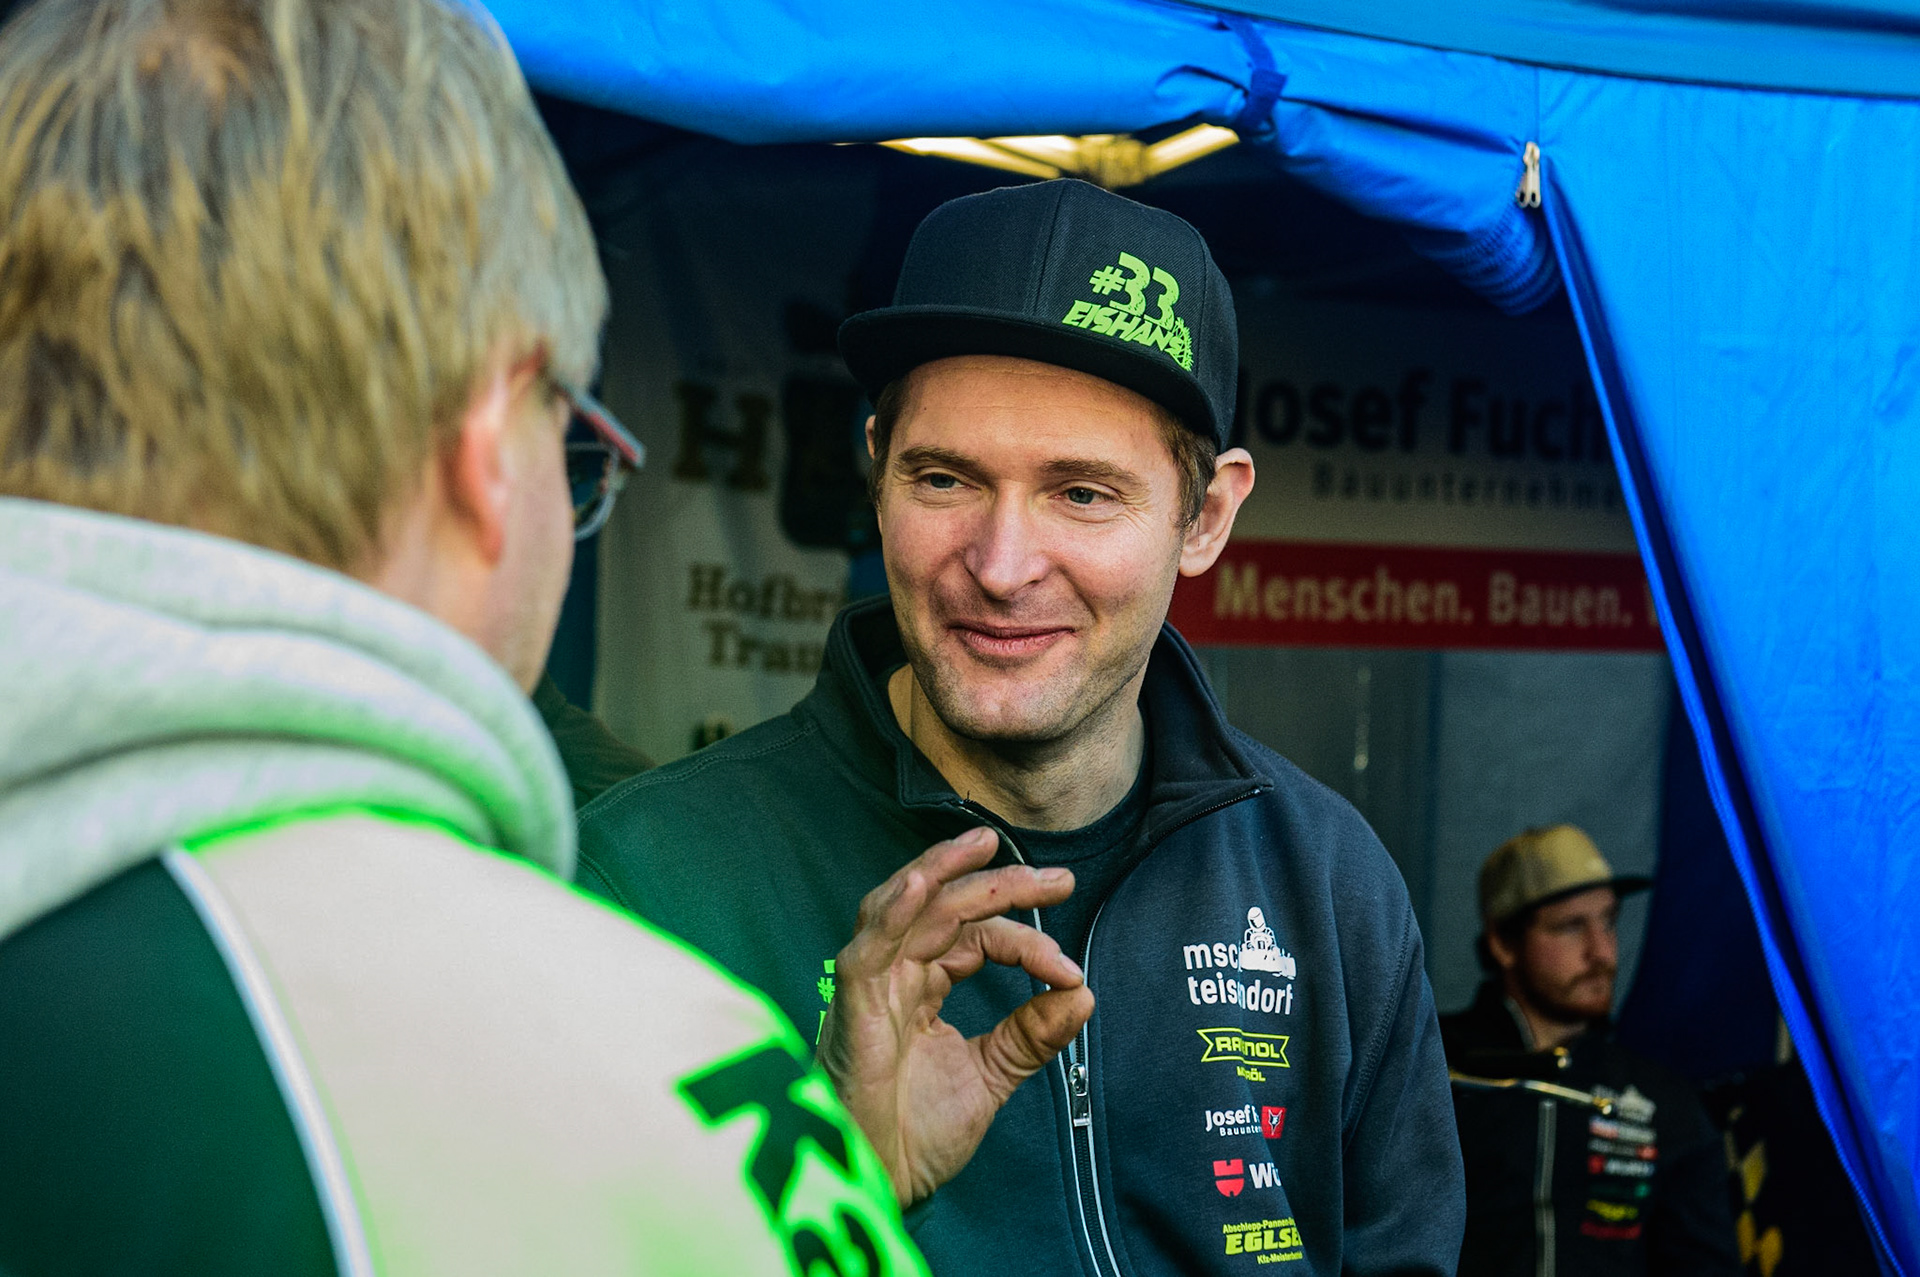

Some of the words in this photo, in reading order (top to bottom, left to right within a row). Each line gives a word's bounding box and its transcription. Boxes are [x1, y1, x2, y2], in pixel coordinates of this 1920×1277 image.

[1089, 252, 1180, 331] #33
[1061, 300, 1184, 355] EISHANS
[1212, 560, 1474, 625] Menschen.
[1487, 570, 1634, 629] Bauen.
[1183, 943, 1238, 970] msc
[1187, 972, 1293, 1015] teisndorf
[1205, 1104, 1250, 1132] Josef
